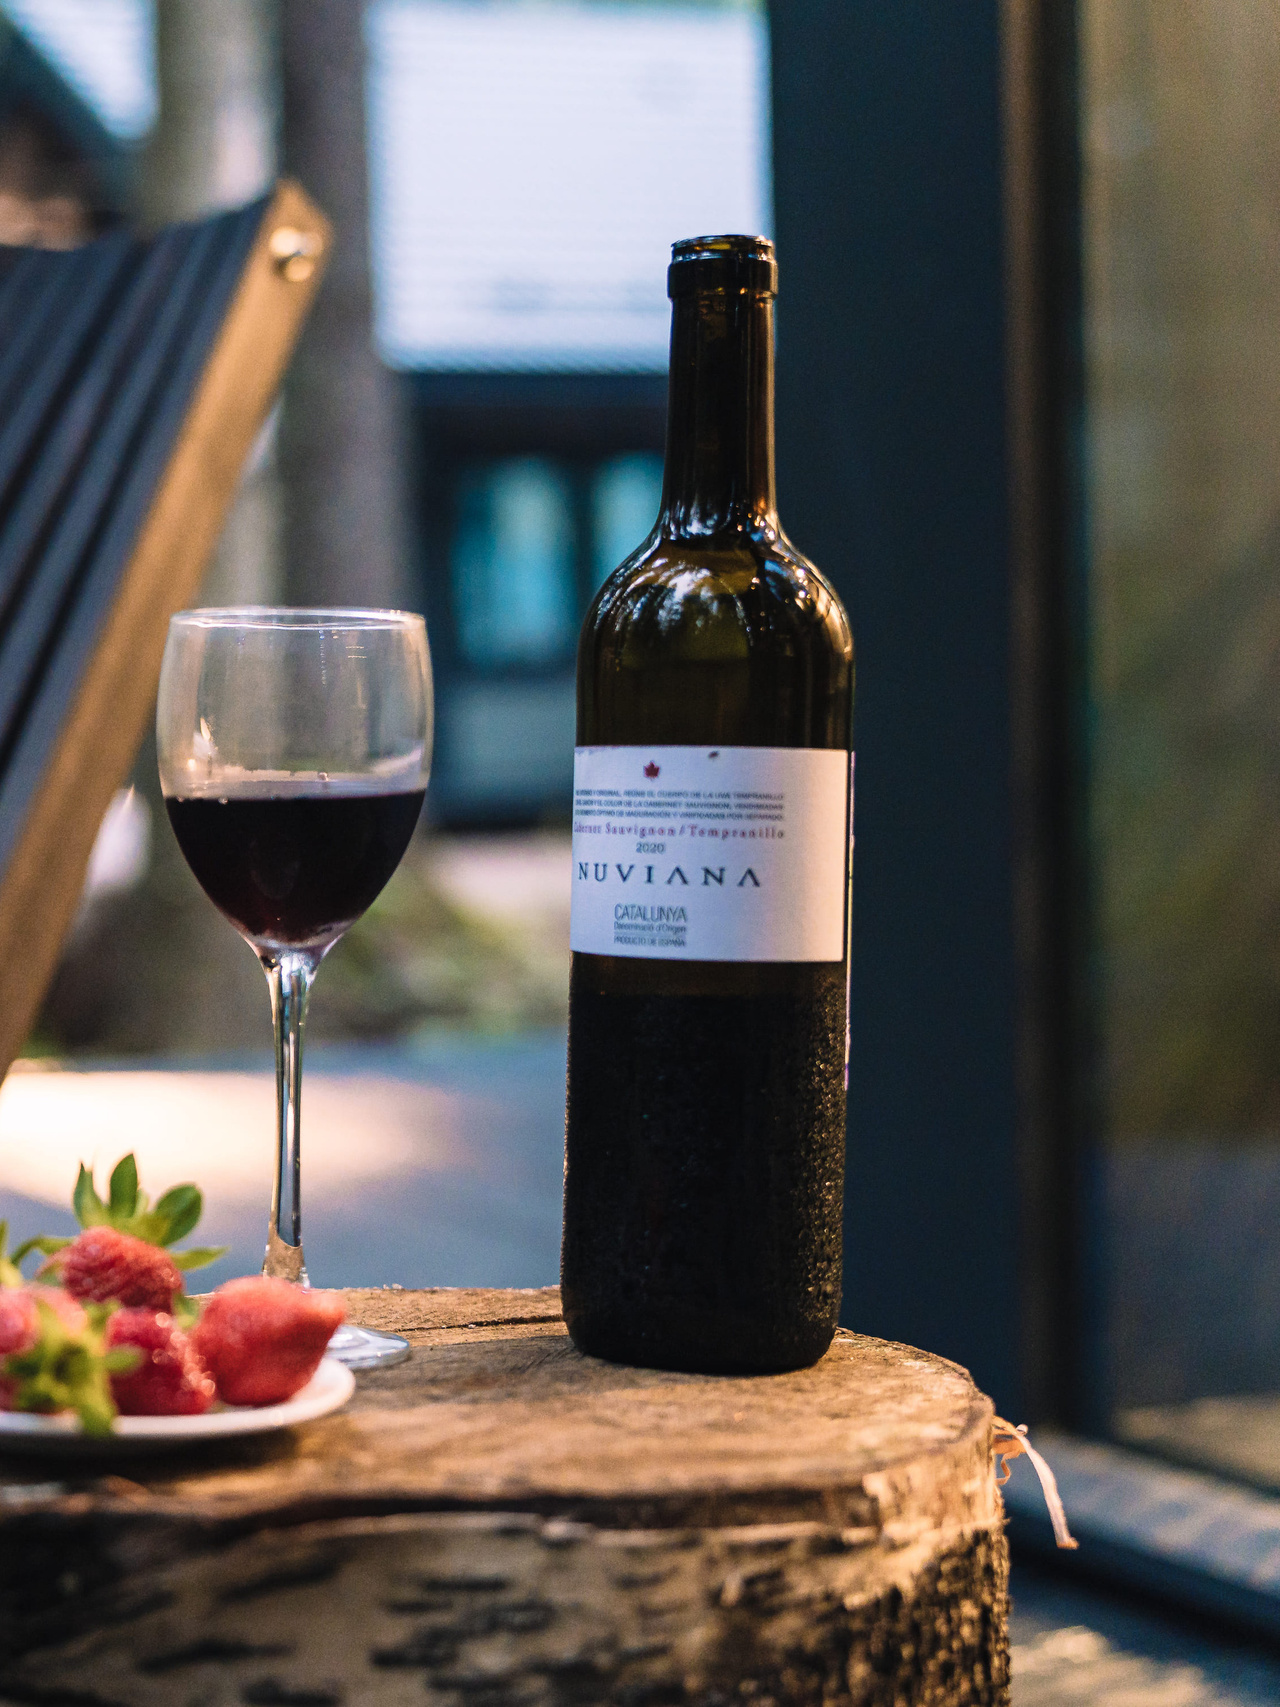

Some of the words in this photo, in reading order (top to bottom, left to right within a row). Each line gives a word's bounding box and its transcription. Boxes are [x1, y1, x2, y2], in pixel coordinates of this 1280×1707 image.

[636, 842, 664, 854] 2020
[578, 862, 760, 887] NUVIANA
[614, 903, 688, 922] CATALUNYA
